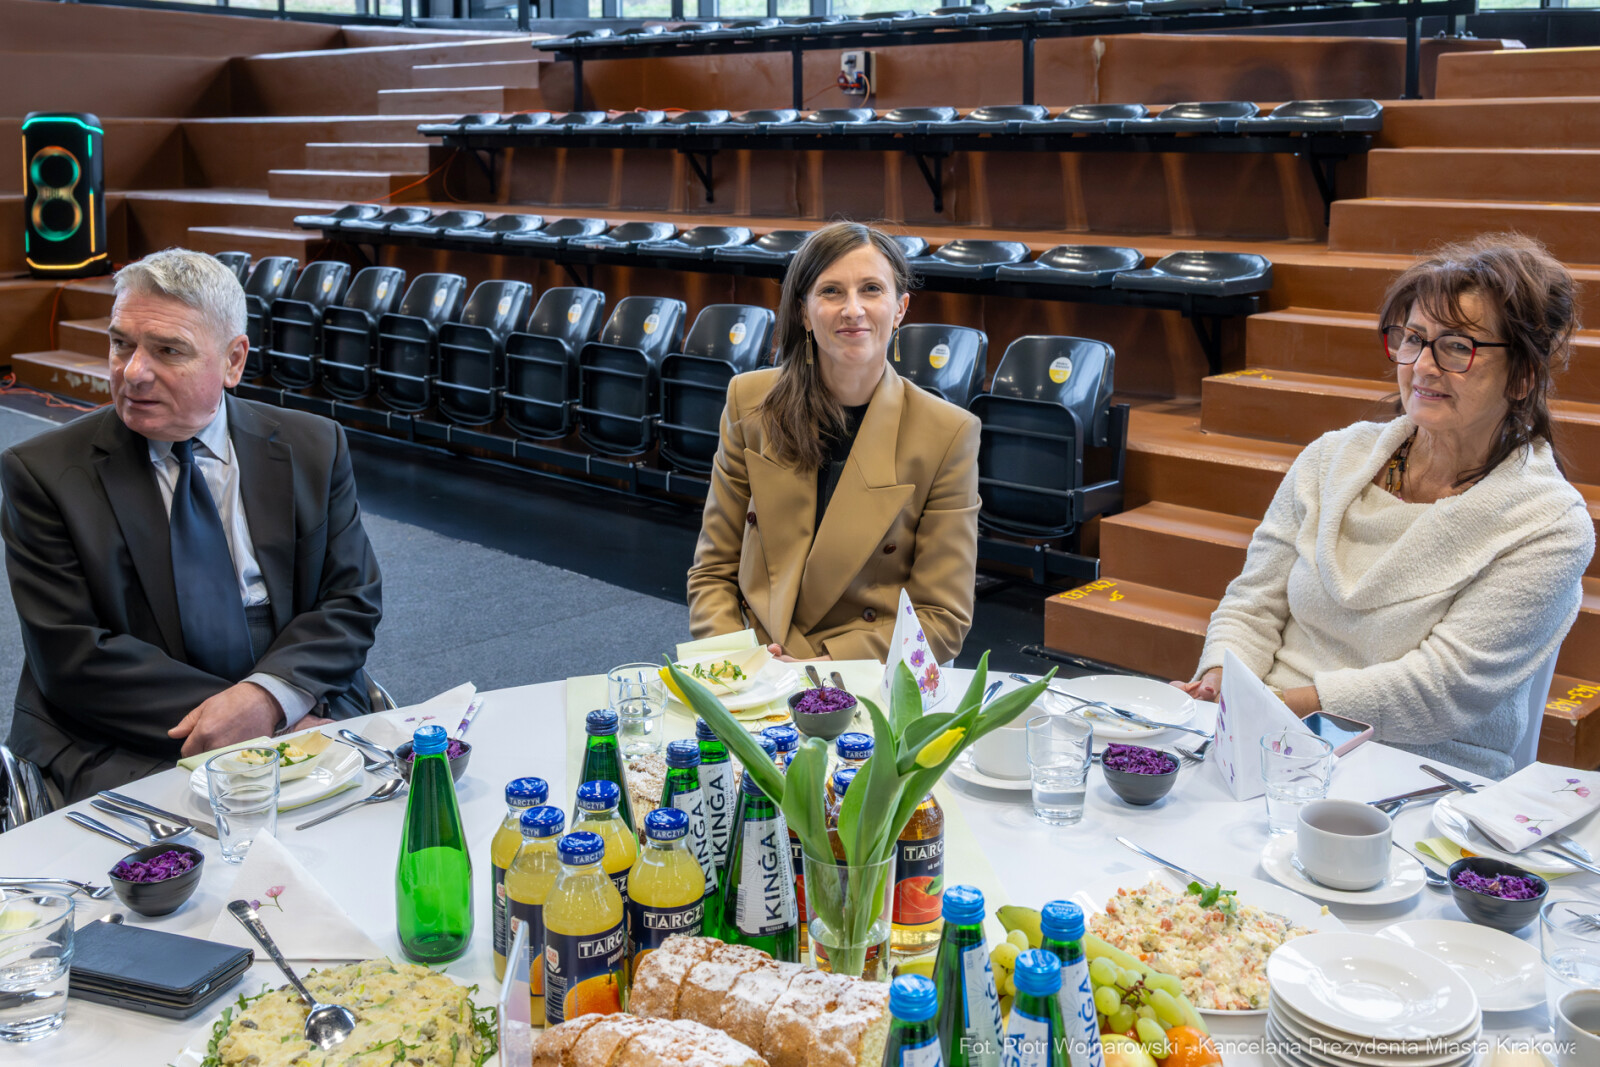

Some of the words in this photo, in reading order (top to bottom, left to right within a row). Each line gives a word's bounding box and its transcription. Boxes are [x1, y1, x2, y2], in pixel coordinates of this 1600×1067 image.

[509, 796, 541, 807] TARCZYN
[578, 800, 605, 810] ARCZYN
[708, 774, 727, 857] KINGA
[651, 828, 686, 840] TARCZYN
[760, 830, 782, 921] KINGA
[644, 907, 703, 929] TARCZ
